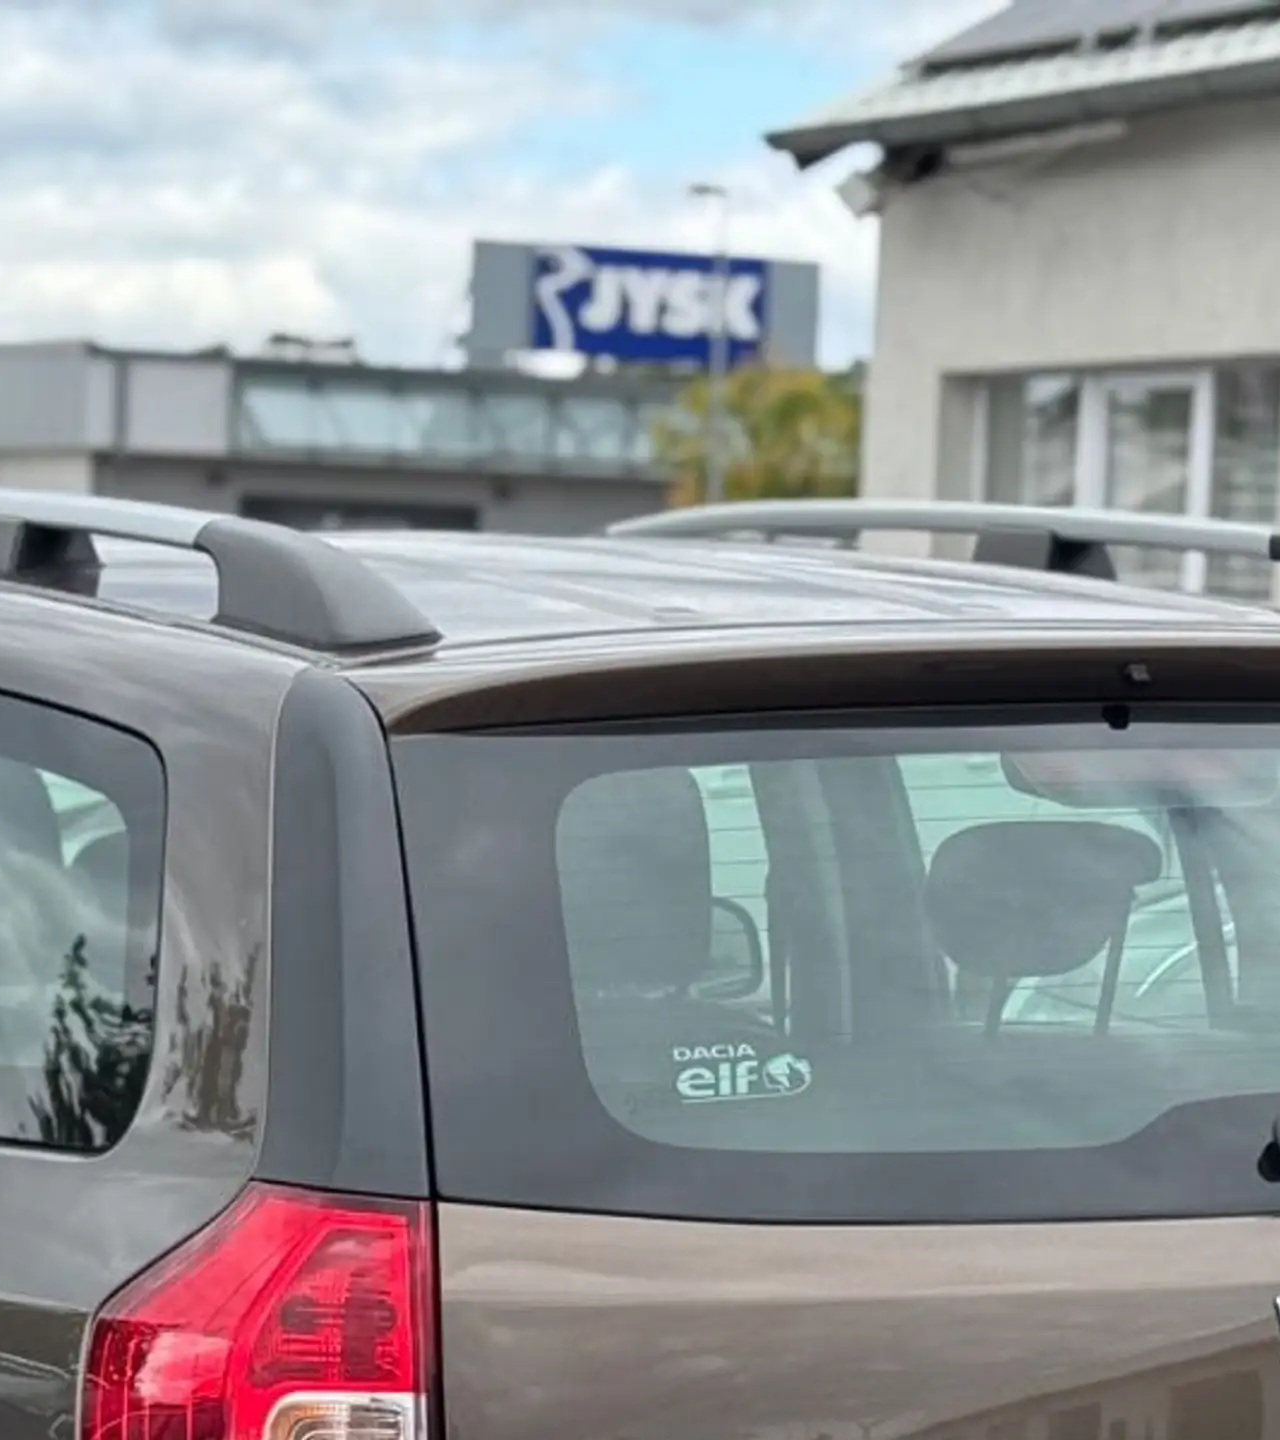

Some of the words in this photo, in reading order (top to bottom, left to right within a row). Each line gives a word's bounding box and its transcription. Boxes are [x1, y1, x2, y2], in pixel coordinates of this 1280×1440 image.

[581, 266, 760, 339] JYSK
[673, 1043, 755, 1060] DACIA
[676, 1060, 758, 1098] elf
